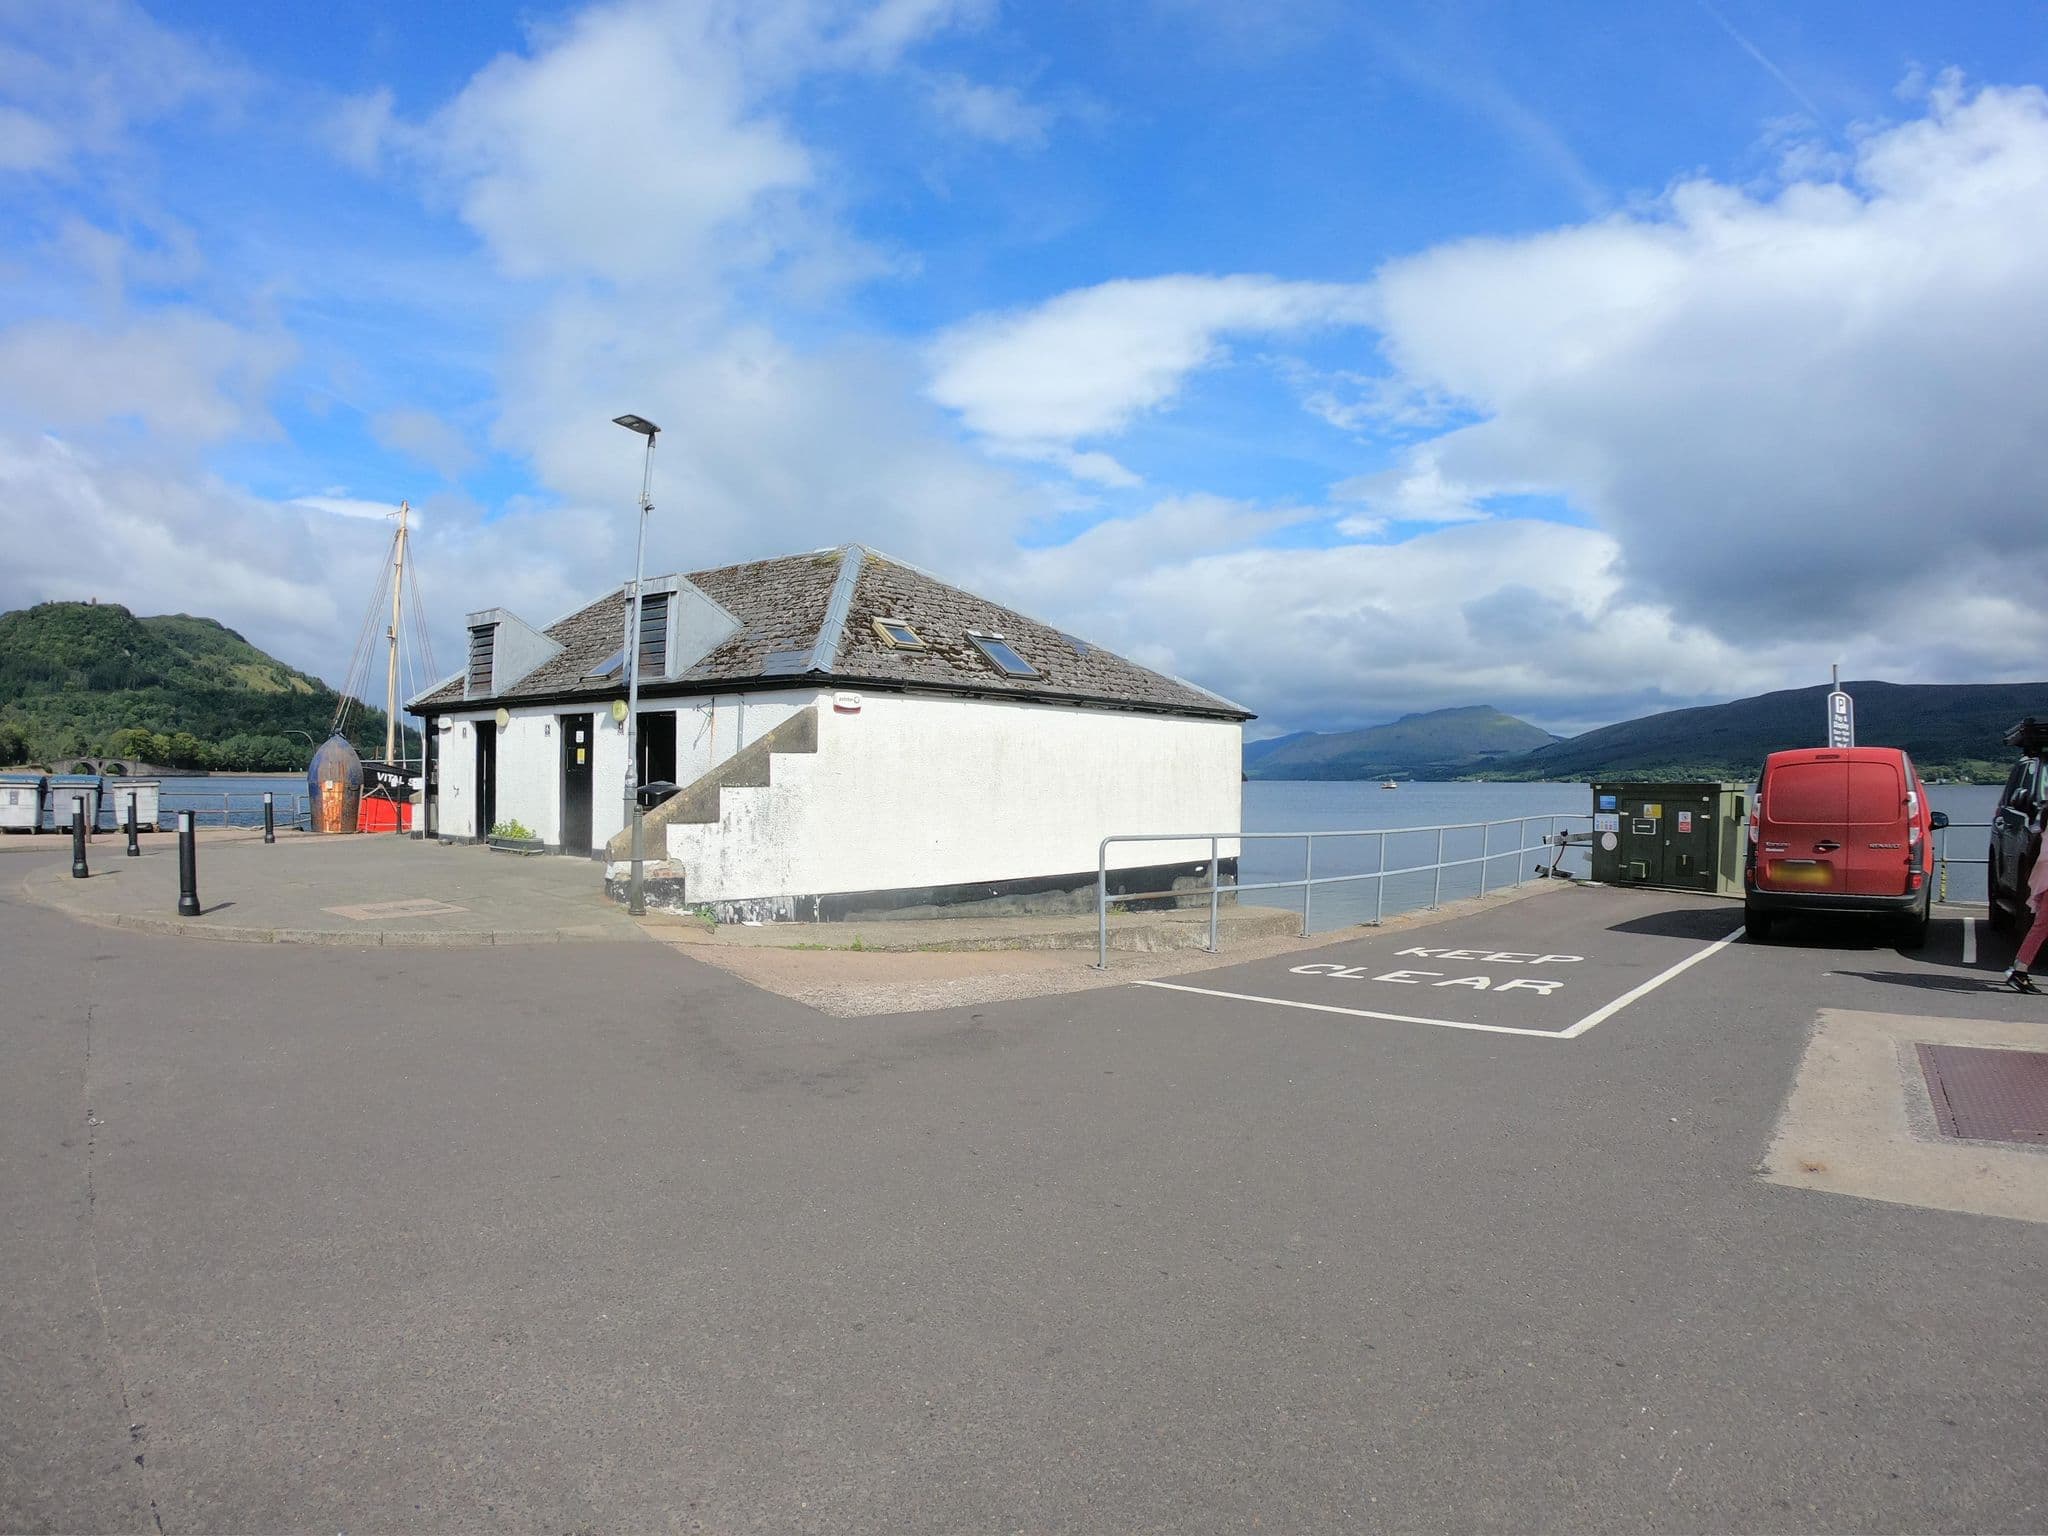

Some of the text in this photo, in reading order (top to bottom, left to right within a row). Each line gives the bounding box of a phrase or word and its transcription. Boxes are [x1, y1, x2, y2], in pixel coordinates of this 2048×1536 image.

[377, 772, 404, 785] VITAL
[1394, 946, 1584, 964] KEEP
[1289, 963, 1564, 995] CLEAR
